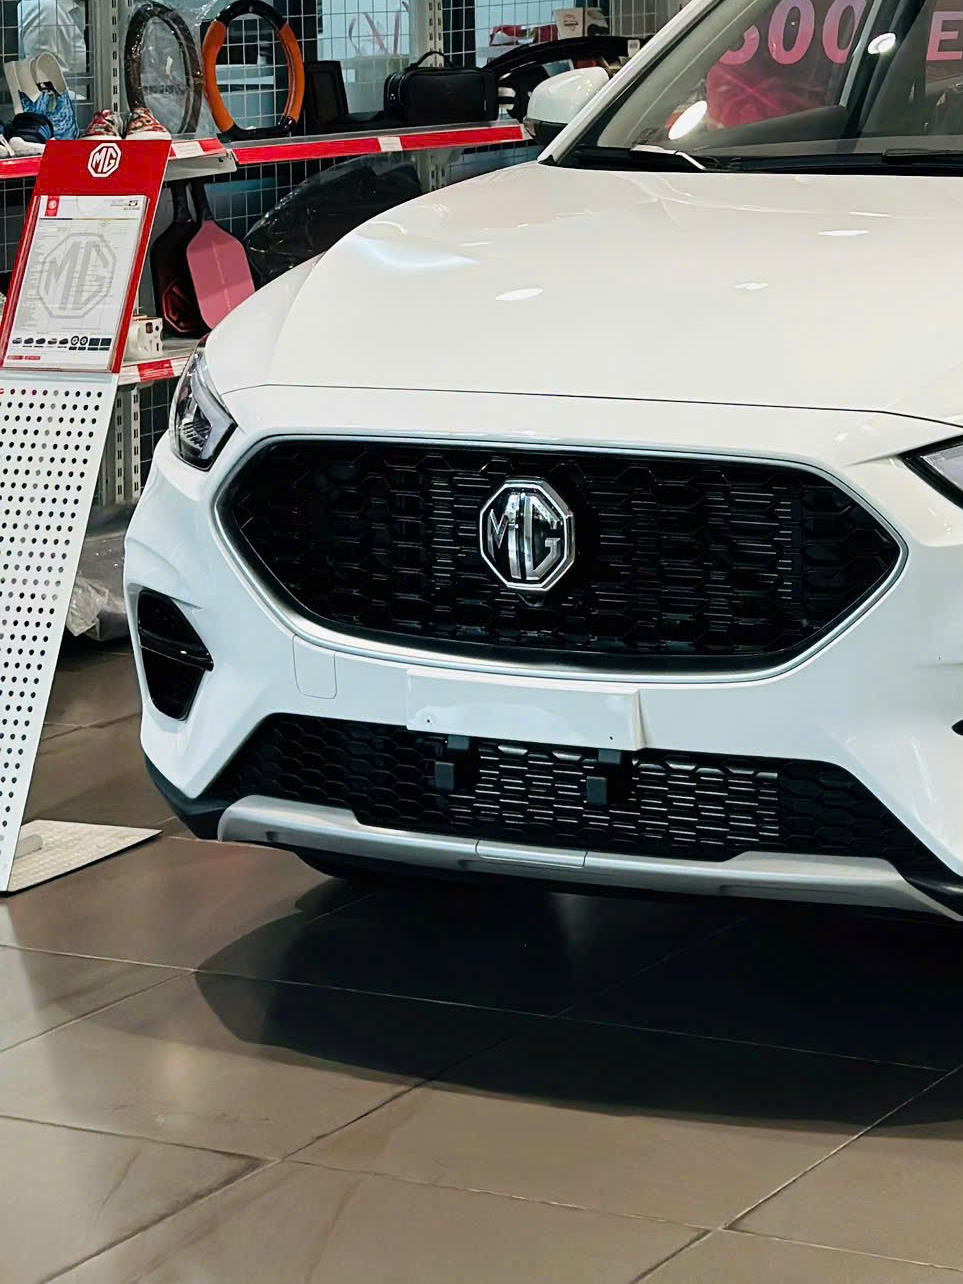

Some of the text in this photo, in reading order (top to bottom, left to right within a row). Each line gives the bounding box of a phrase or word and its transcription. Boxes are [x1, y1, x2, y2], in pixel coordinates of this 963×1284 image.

[90, 145, 119, 175] MG
[42, 238, 112, 313] MG
[486, 489, 565, 583] MG
